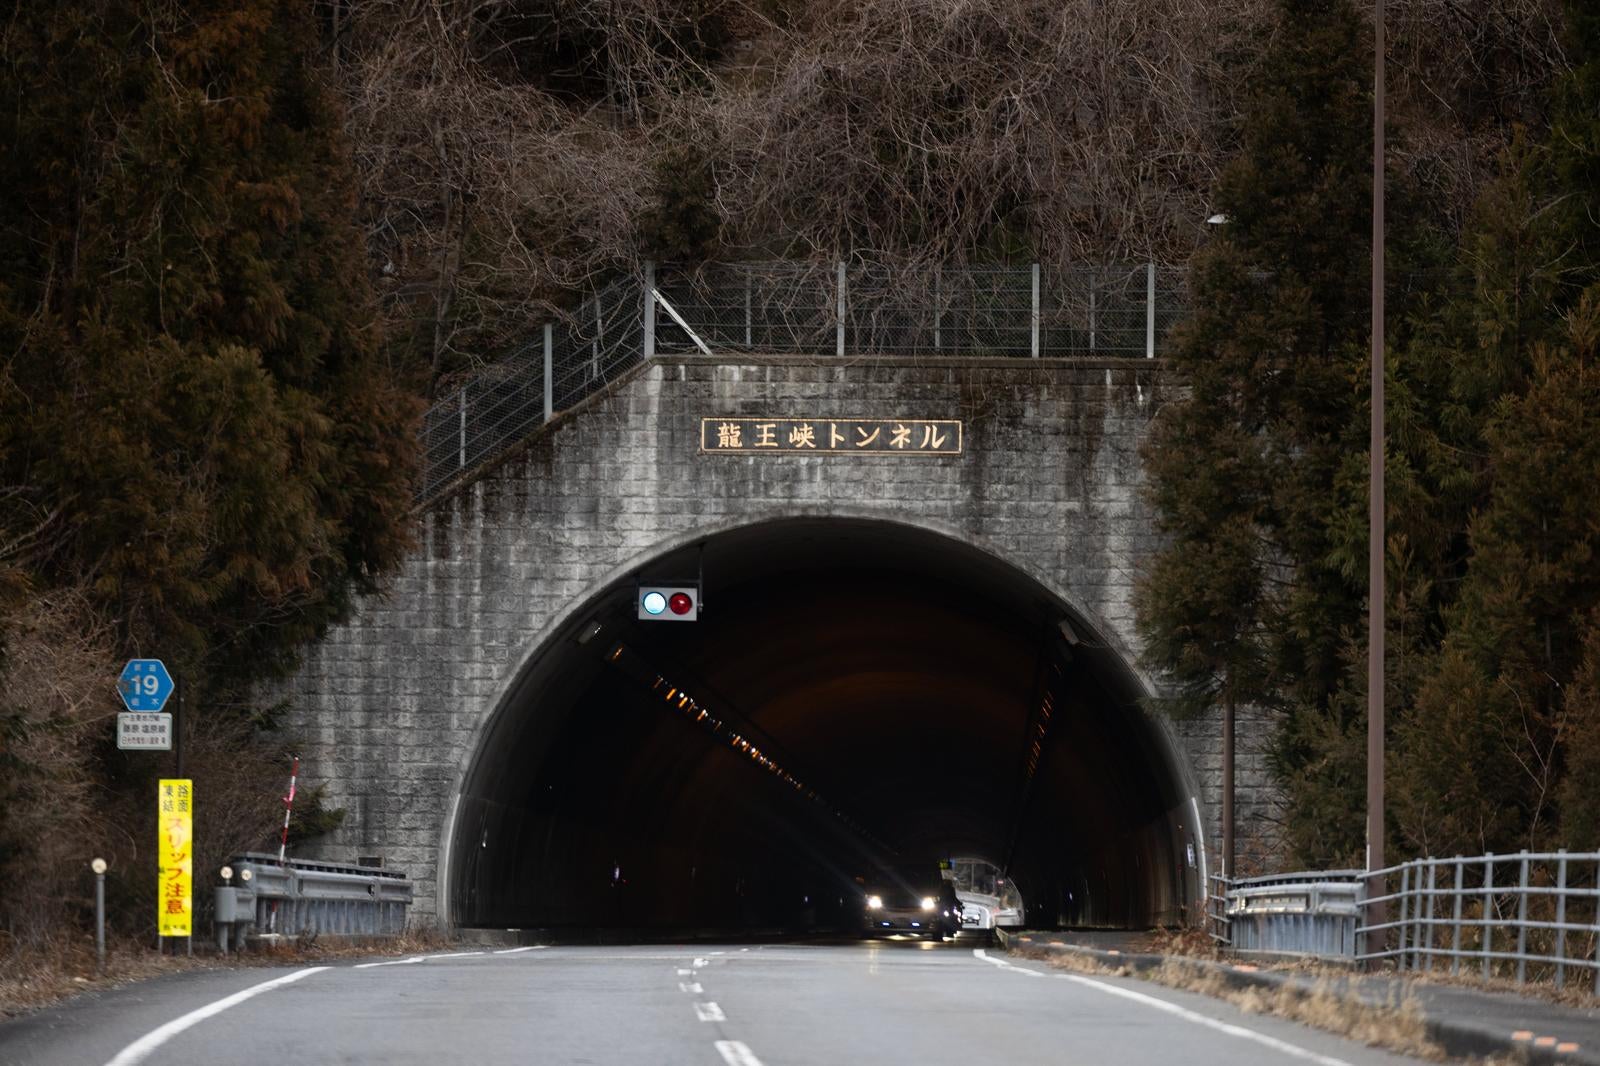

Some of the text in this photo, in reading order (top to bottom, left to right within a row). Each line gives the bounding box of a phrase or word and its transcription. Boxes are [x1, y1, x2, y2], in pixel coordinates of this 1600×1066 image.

[717, 422, 946, 449] 龍王峡トンネル
[131, 674, 159, 696] 19
